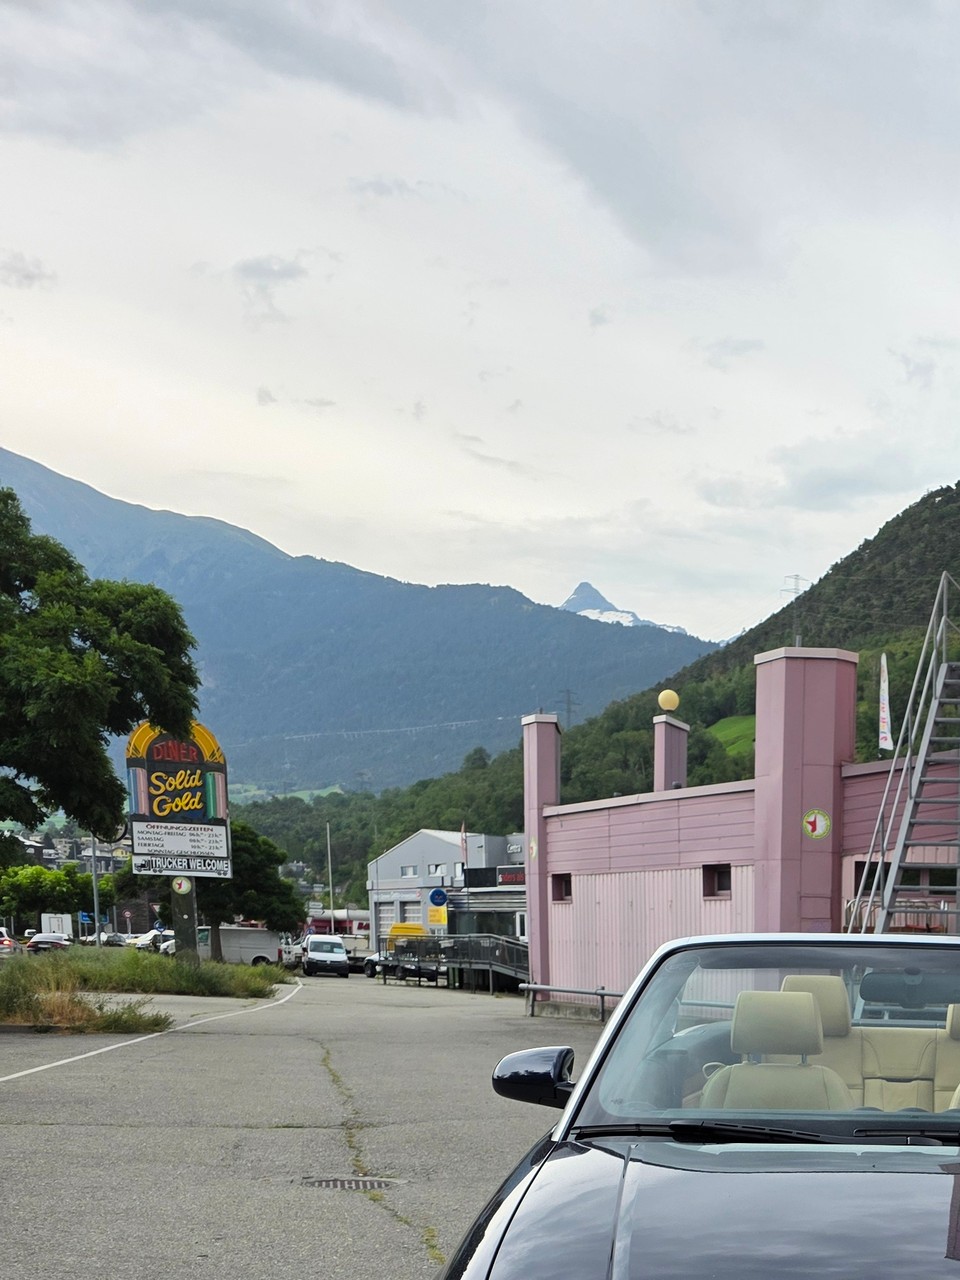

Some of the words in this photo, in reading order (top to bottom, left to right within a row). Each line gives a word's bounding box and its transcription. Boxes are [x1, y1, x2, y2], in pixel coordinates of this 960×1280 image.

[153, 740, 198, 762] DINER
[149, 769, 203, 795] Solid
[153, 792, 203, 816] Gold
[152, 857, 188, 869] TRUCKER
[189, 858, 229, 871] WELCOME
